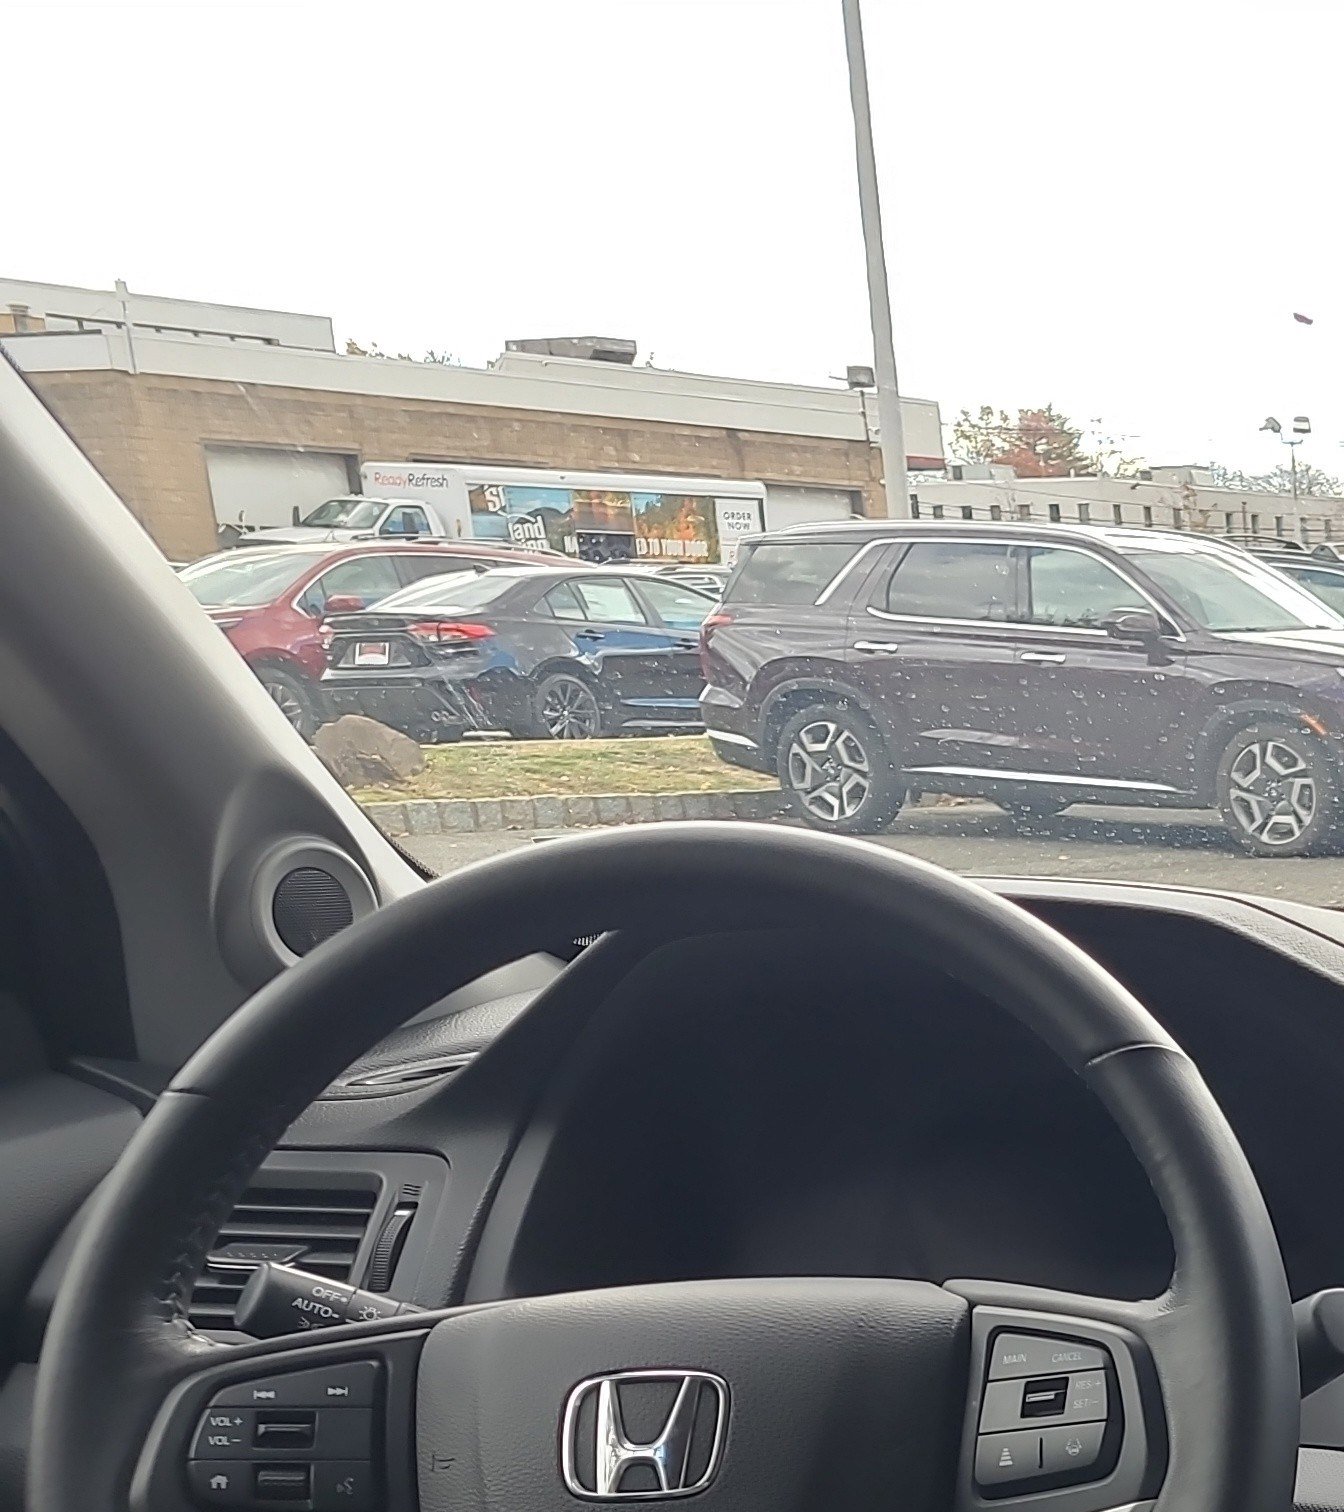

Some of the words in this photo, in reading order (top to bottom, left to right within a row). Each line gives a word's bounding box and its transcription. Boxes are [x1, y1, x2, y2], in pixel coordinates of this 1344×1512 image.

[374, 472, 449, 488] ReadyRefresh
[723, 511, 751, 521] ORDER
[727, 522, 750, 530] NOW
[312, 1286, 341, 1302] OFF
[292, 1298, 332, 1318] AUTO
[1002, 1353, 1028, 1364] MAIN
[1051, 1352, 1082, 1363] CANCEL
